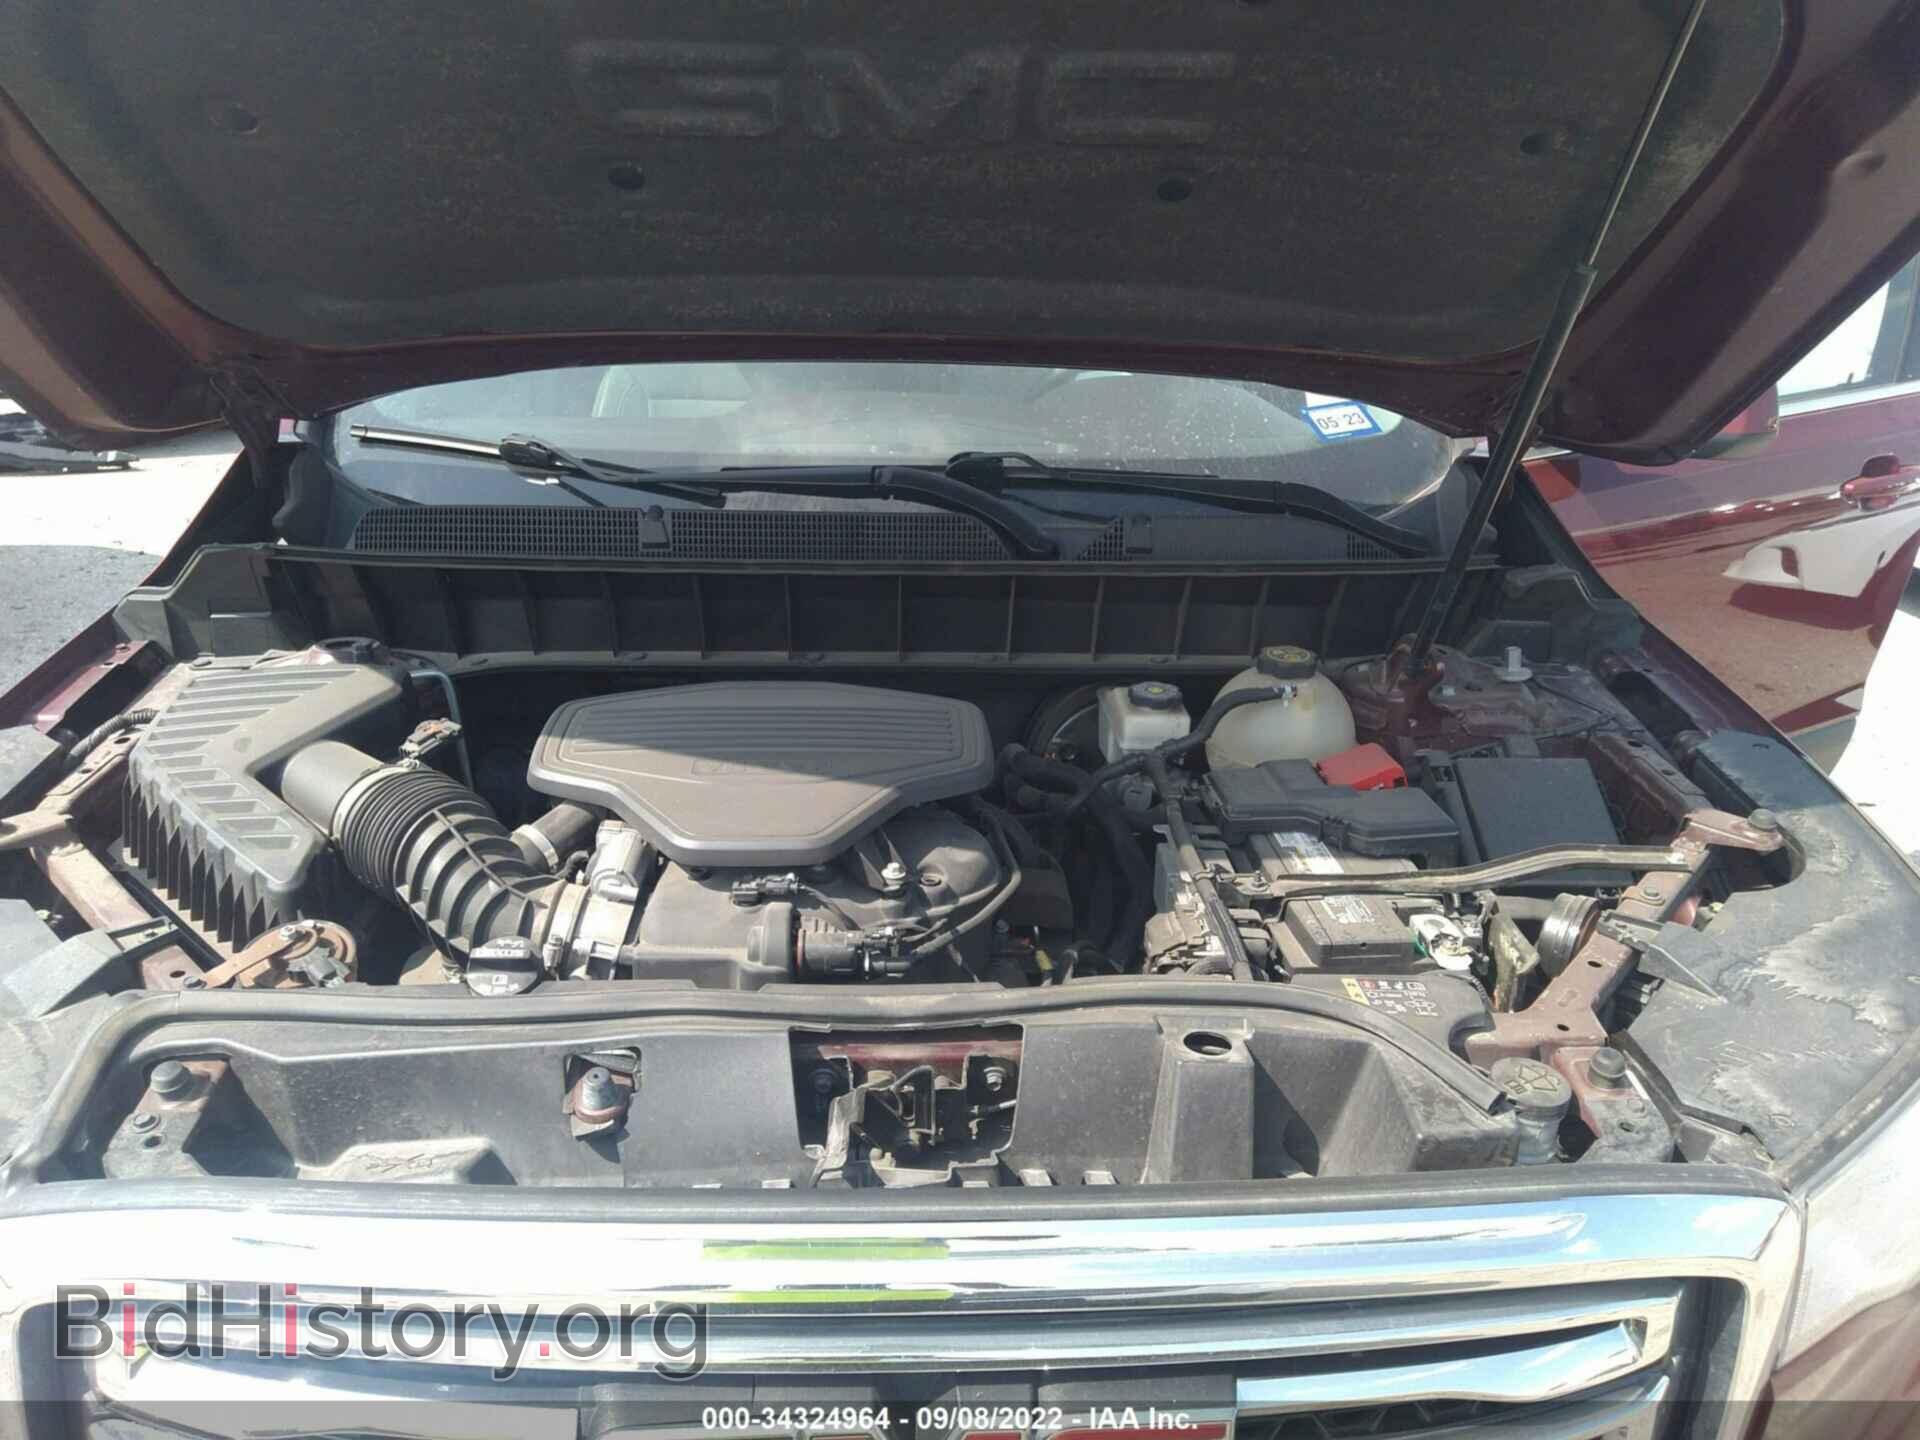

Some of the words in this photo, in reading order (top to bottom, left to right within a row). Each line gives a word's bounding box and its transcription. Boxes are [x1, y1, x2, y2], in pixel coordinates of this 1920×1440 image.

[563, 38, 1237, 144] GMC
[1316, 415, 1339, 430] 05
[1343, 412, 1366, 426] 23
